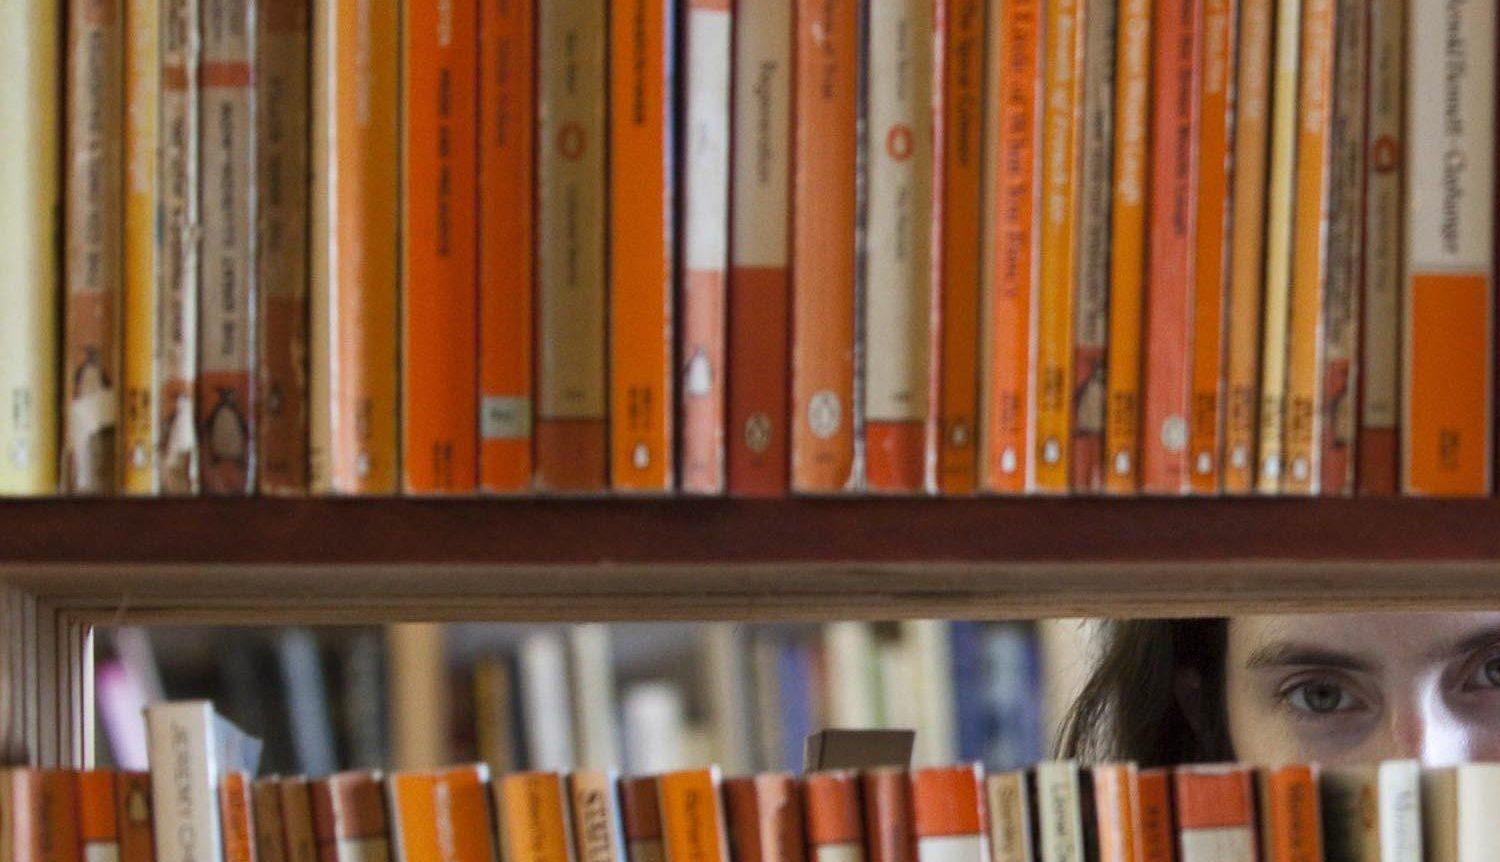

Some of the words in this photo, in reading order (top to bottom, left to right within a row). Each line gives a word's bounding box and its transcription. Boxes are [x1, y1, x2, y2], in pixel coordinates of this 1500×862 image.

[755, 60, 780, 184] Regeneration
[1006, 112, 1029, 176] What
[1006, 184, 1026, 222] You
[1440, 150, 1466, 255] Clayhanger
[1003, 230, 1024, 298] Fancy
[170, 720, 195, 820] JEREMY
